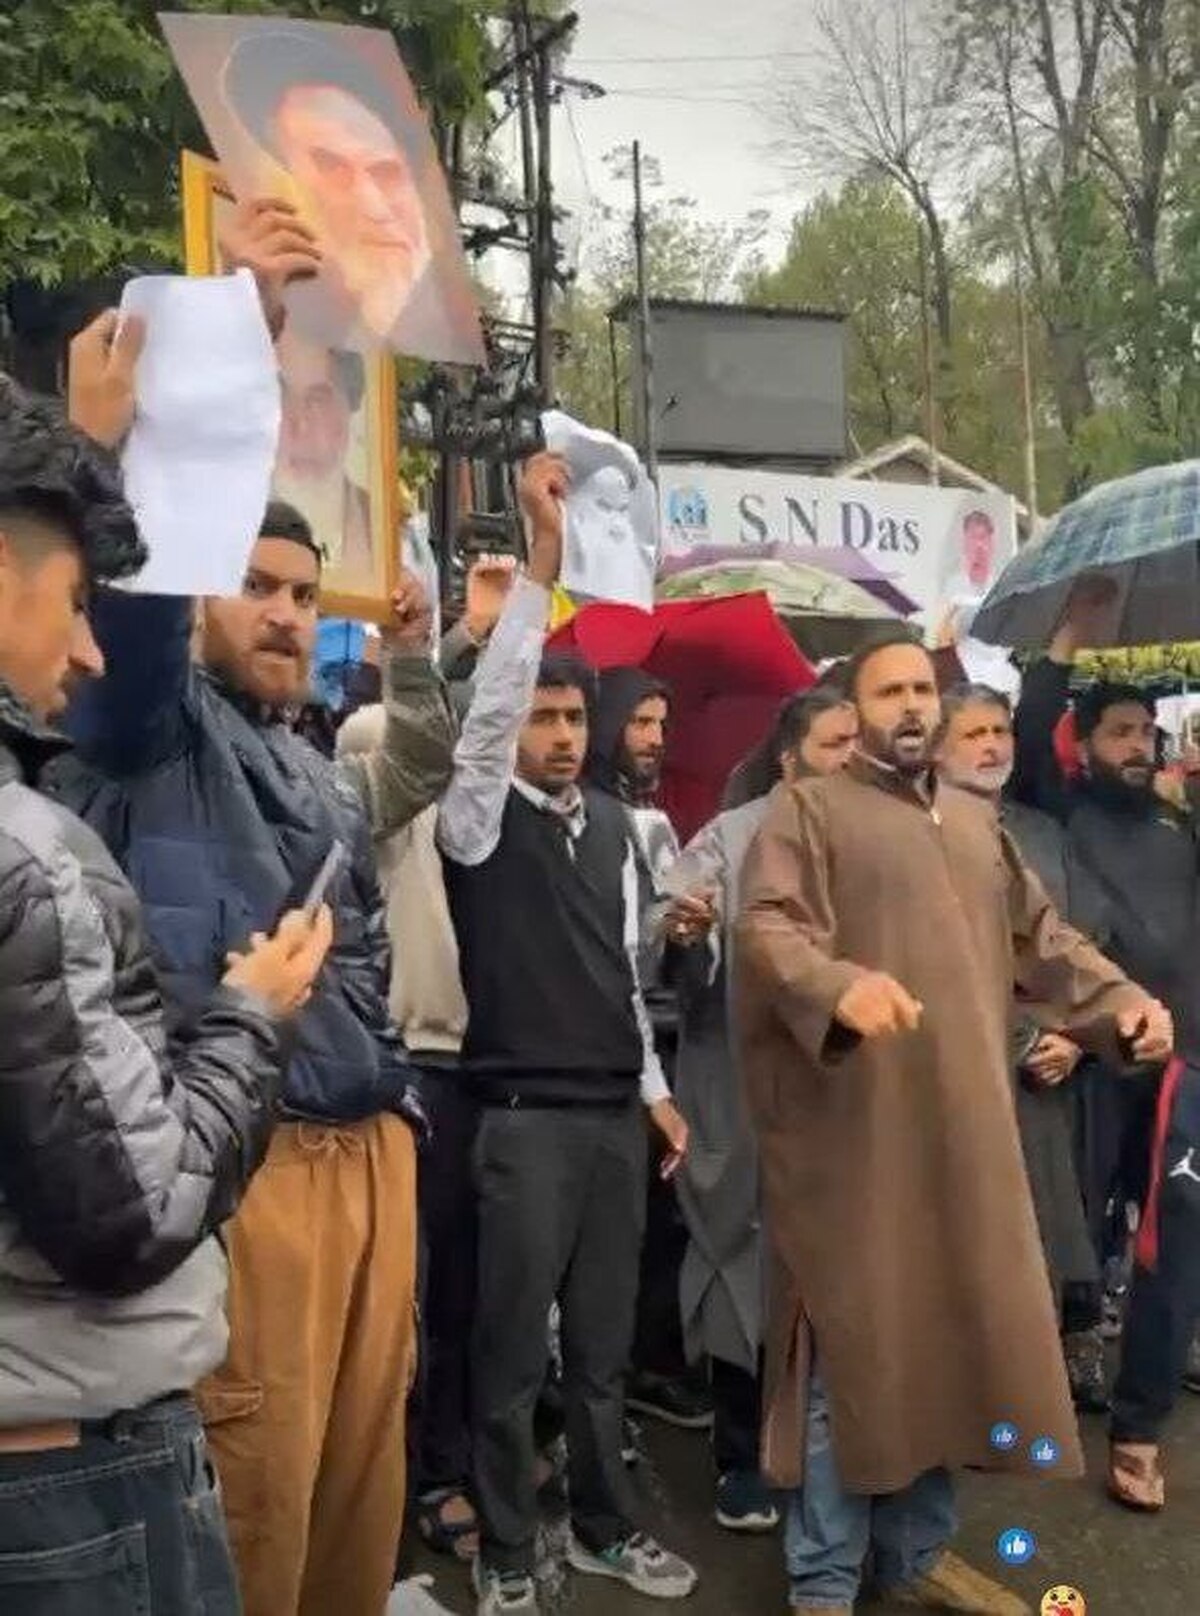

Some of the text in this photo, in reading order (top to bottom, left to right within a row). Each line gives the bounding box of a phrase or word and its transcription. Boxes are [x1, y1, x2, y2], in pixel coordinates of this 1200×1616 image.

[738, 494, 920, 555] S N Das
